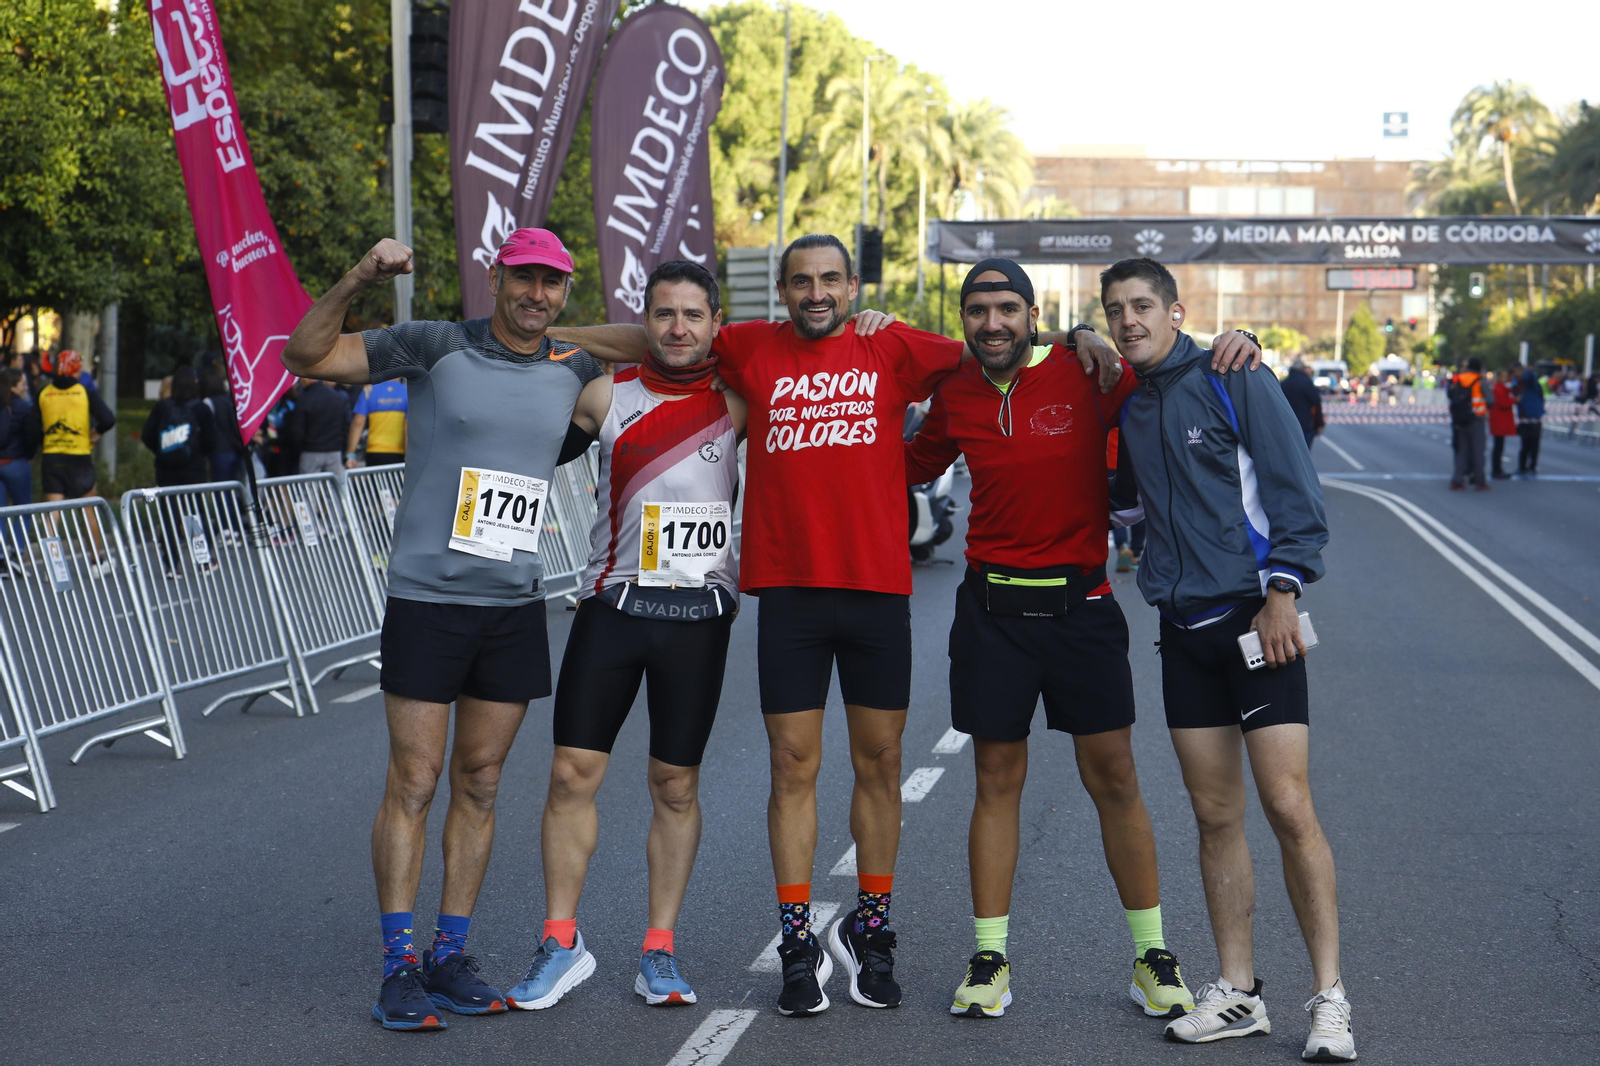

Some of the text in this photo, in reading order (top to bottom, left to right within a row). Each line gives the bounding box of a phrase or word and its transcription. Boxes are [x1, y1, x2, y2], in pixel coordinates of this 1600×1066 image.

[606, 28, 708, 246] IMDECO
[521, 138, 552, 200] Instituto
[650, 206, 674, 255] Instituto
[664, 156, 691, 209] Municipal
[1055, 234, 1112, 247] IMDECO
[1191, 221, 1556, 243] 36 MEDIA MARATÓN DE CÓRDOBA
[1344, 244, 1401, 259] SALIDA
[768, 400, 875, 423] POR NUESTROS
[765, 417, 878, 454] COLORES
[492, 473, 526, 488] IMDECO
[479, 488, 540, 527] 1701
[672, 506, 708, 515] IMDECO
[477, 519, 496, 527] ANTONIO
[646, 528, 655, 556] CAJÓN
[662, 520, 727, 550] 1700
[633, 599, 709, 618] EVADICT
